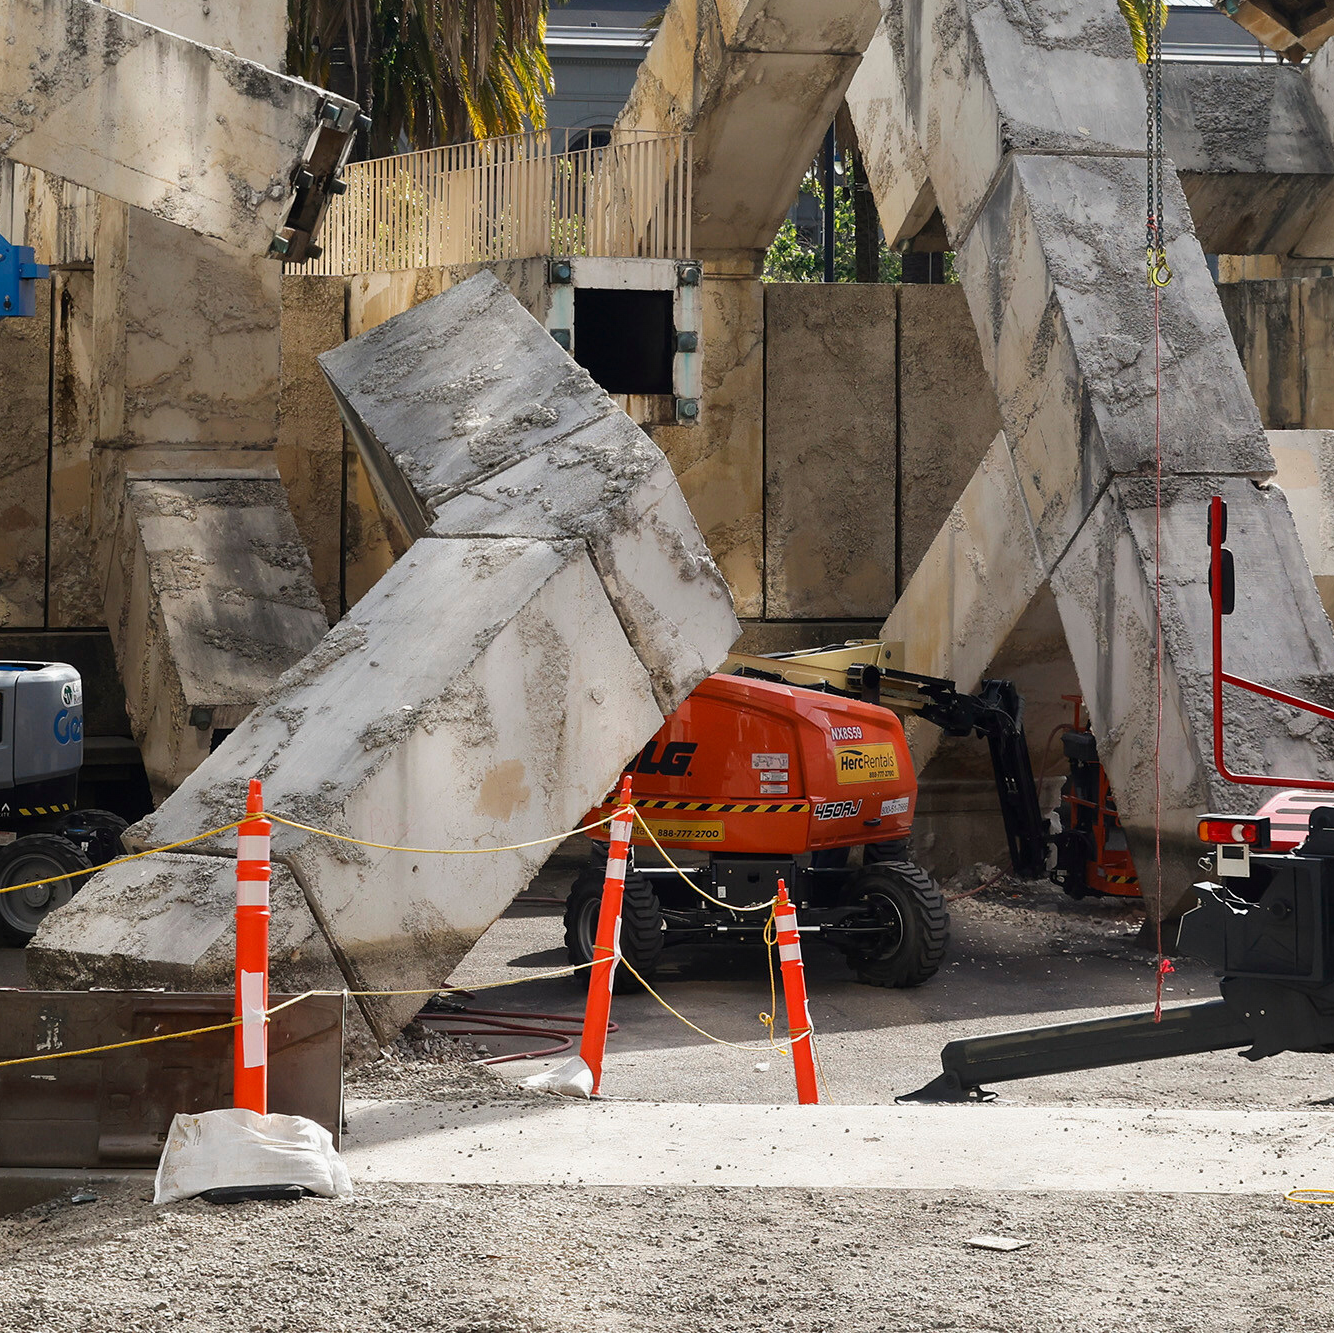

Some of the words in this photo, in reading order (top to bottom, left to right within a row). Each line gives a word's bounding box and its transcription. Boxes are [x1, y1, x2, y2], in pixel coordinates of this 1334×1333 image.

[840, 753, 895, 771] HercRentals
[814, 799, 863, 821] 450AJ
[657, 829, 719, 838] 888-777-2700
